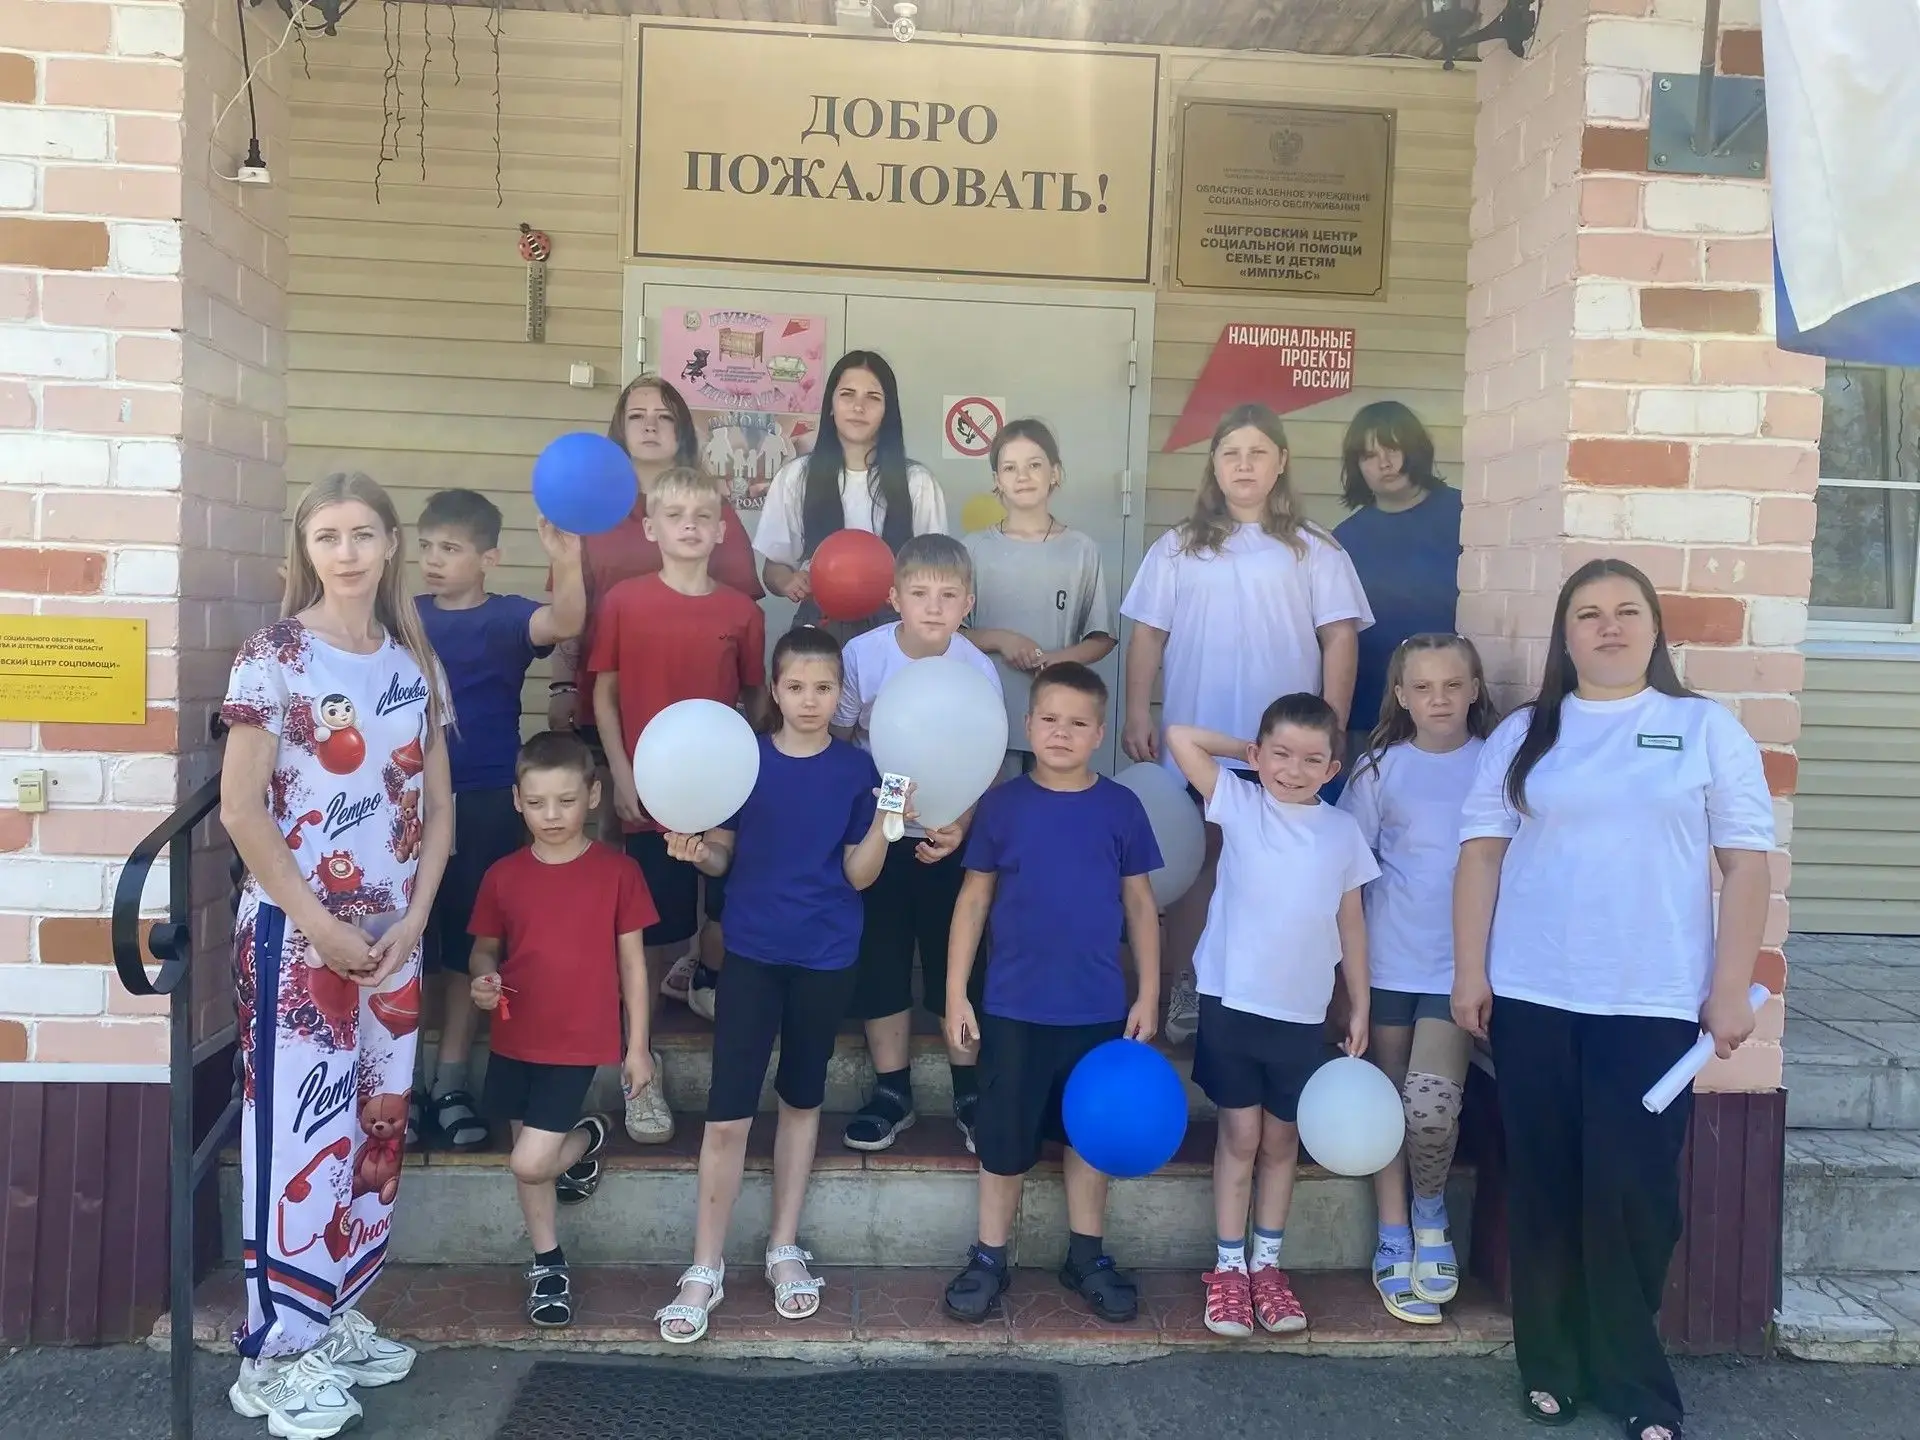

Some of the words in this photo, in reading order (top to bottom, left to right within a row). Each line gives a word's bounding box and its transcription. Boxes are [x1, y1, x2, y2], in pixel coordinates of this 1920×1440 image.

[801, 94, 998, 146] ДОБРО
[683, 150, 1110, 213] ПОЖАЛОВАТЬ!
[1196, 185, 1254, 196] ОБЛАСТНОЕ
[1256, 187, 1305, 198] КАЗЕННОЕ
[1307, 190, 1371, 202] УЧРЕЖДЕНИЕ
[1208, 196, 1280, 208] СОЦИАЛЬНОГО
[1282, 199, 1361, 212] ОБСЛУЖИВАНИЯ
[1206, 225, 1309, 239] «ЩИГРОВСКИЙ
[1312, 230, 1358, 242] ЦЕНТР
[1200, 238, 1296, 252] СОЦИАЛЬНОЙ
[1299, 243, 1362, 256] ПОМОЩИ
[1225, 252, 1271, 264] СЕМЬЕ
[1275, 255, 1285, 265] И
[1289, 256, 1336, 268] ДЕТЯМ
[1239, 267, 1320, 281] «ИМПУЛЬС»
[1228, 326, 1353, 349] НАЦИОНАЛЬНЫЕ
[1281, 348, 1351, 369] ПРОЕКТЫ
[1292, 369, 1350, 389] РОССИИ
[30, 659, 57, 667] ЦЕНТР
[58, 660, 121, 669] СОЦПОМОЩИ»
[375, 672, 430, 715] Москва
[322, 791, 383, 840] Ретро
